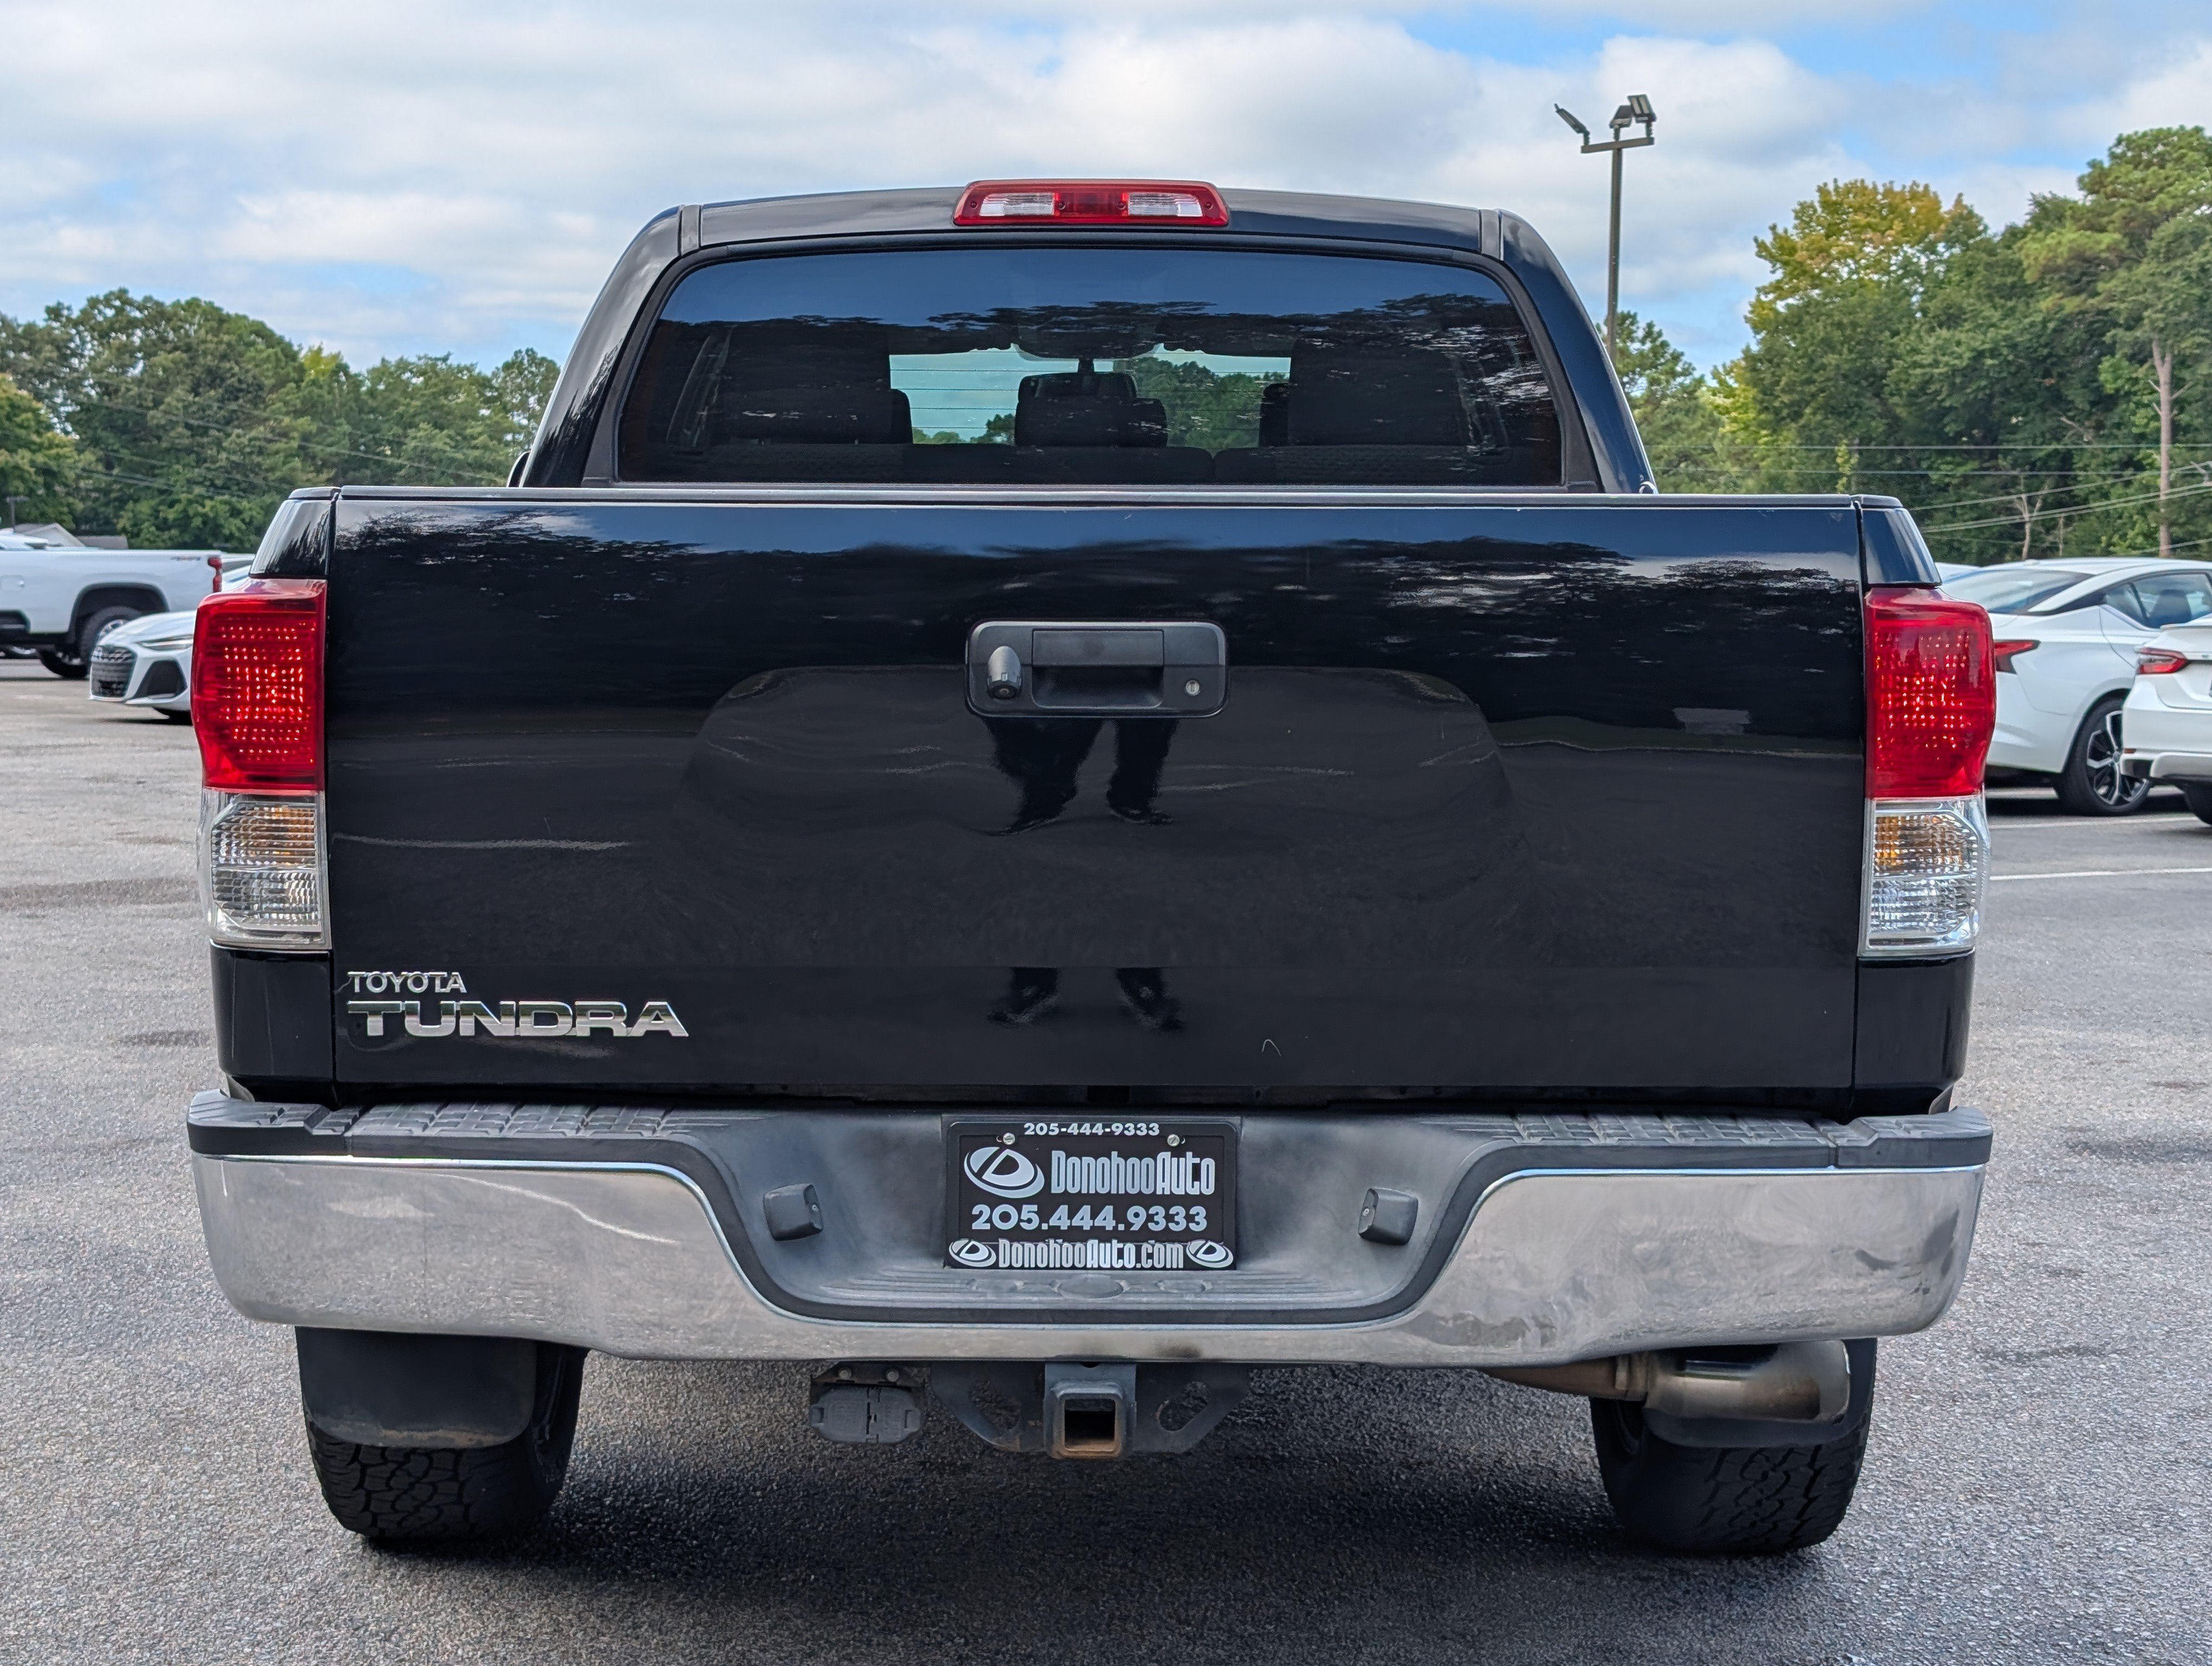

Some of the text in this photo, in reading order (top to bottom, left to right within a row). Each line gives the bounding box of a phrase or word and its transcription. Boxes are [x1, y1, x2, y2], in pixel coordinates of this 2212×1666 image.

[348, 971, 467, 993] TOYOTA
[348, 1001, 689, 1037] TUNDRA
[1023, 1123, 1160, 1136] 205-444-9333
[1051, 1150, 1216, 1195] DonohooAuto
[972, 1204, 1207, 1232] 205.444.9333
[998, 1238, 1184, 1268] DonohooAuto.com
